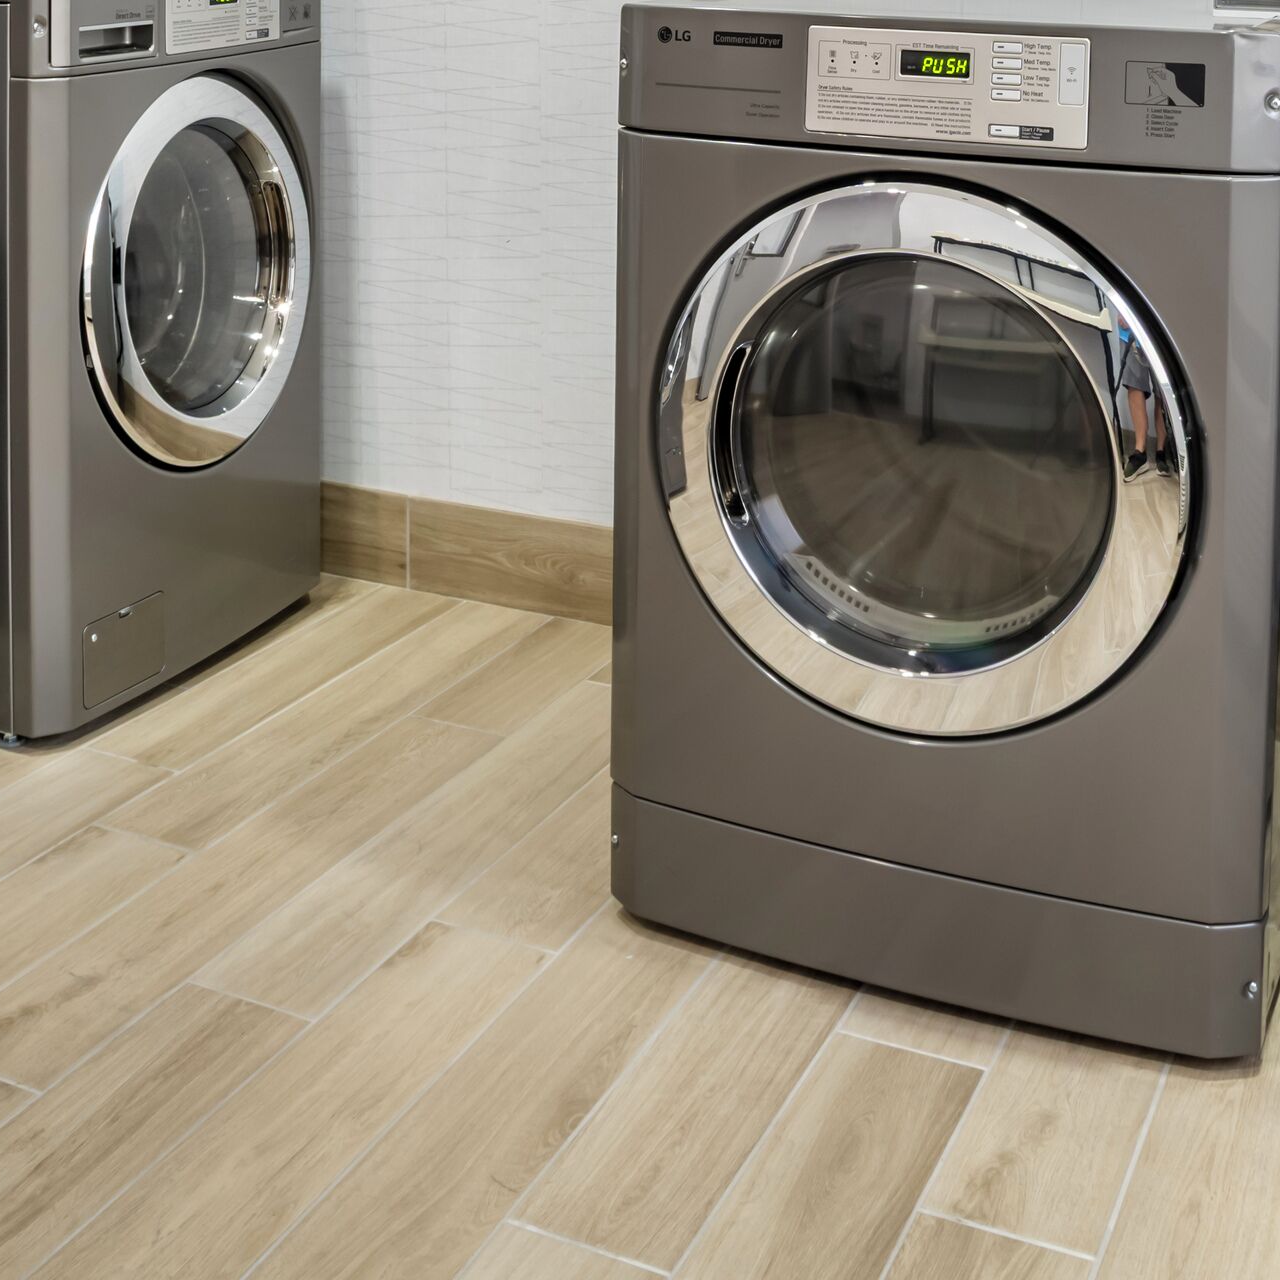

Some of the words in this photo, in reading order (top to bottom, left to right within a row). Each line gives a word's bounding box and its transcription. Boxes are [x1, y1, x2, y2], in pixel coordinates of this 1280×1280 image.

[675, 30, 691, 42] LG
[715, 34, 758, 44] Commercial
[759, 37, 782, 47] Dryer
[921, 56, 967, 74] PUSH
